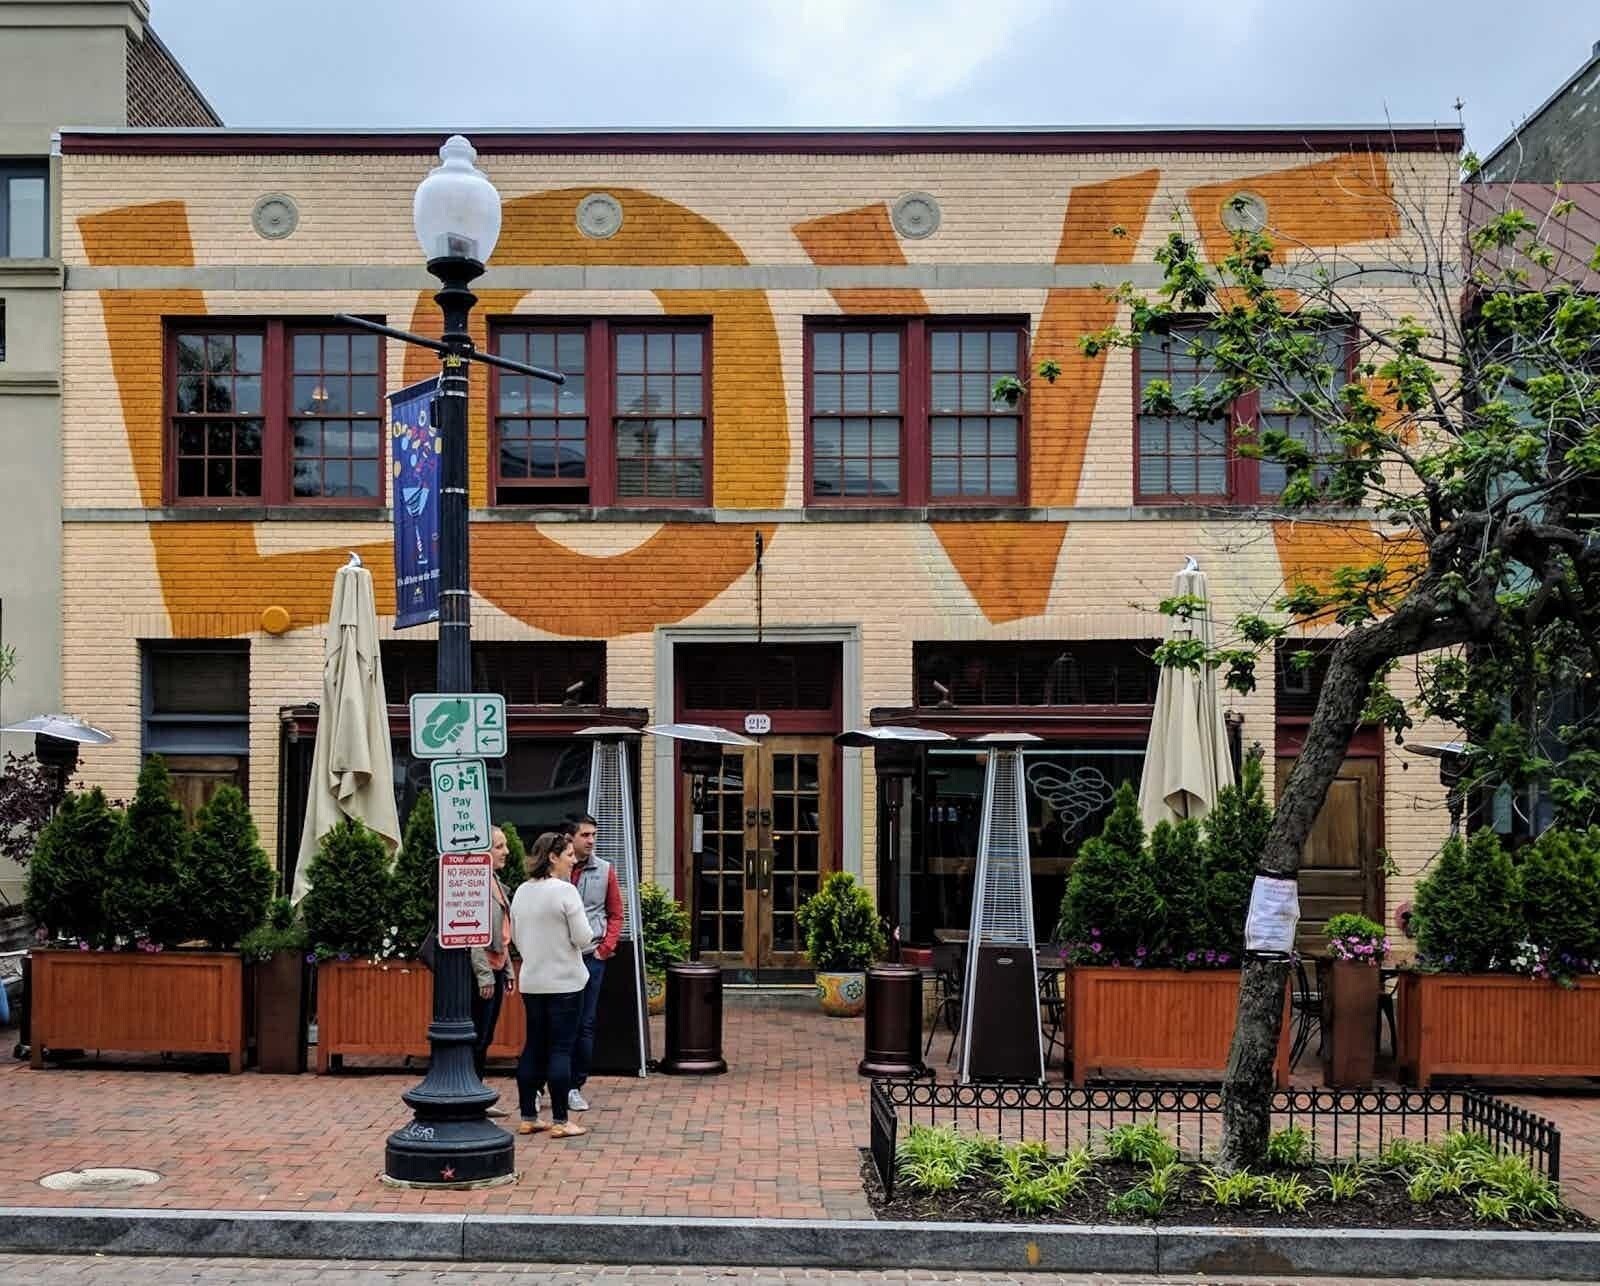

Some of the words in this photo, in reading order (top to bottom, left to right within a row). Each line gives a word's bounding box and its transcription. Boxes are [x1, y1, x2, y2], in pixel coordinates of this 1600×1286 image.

[483, 704, 497, 725] 2
[748, 717, 767, 729] 212
[452, 796, 471, 808] Pay
[457, 810, 470, 820] To
[453, 821, 476, 833] Park
[447, 868, 457, 877] NO
[458, 868, 486, 877] PARKING
[448, 879, 485, 888] SAT-SUN
[456, 910, 476, 918] ONLY
